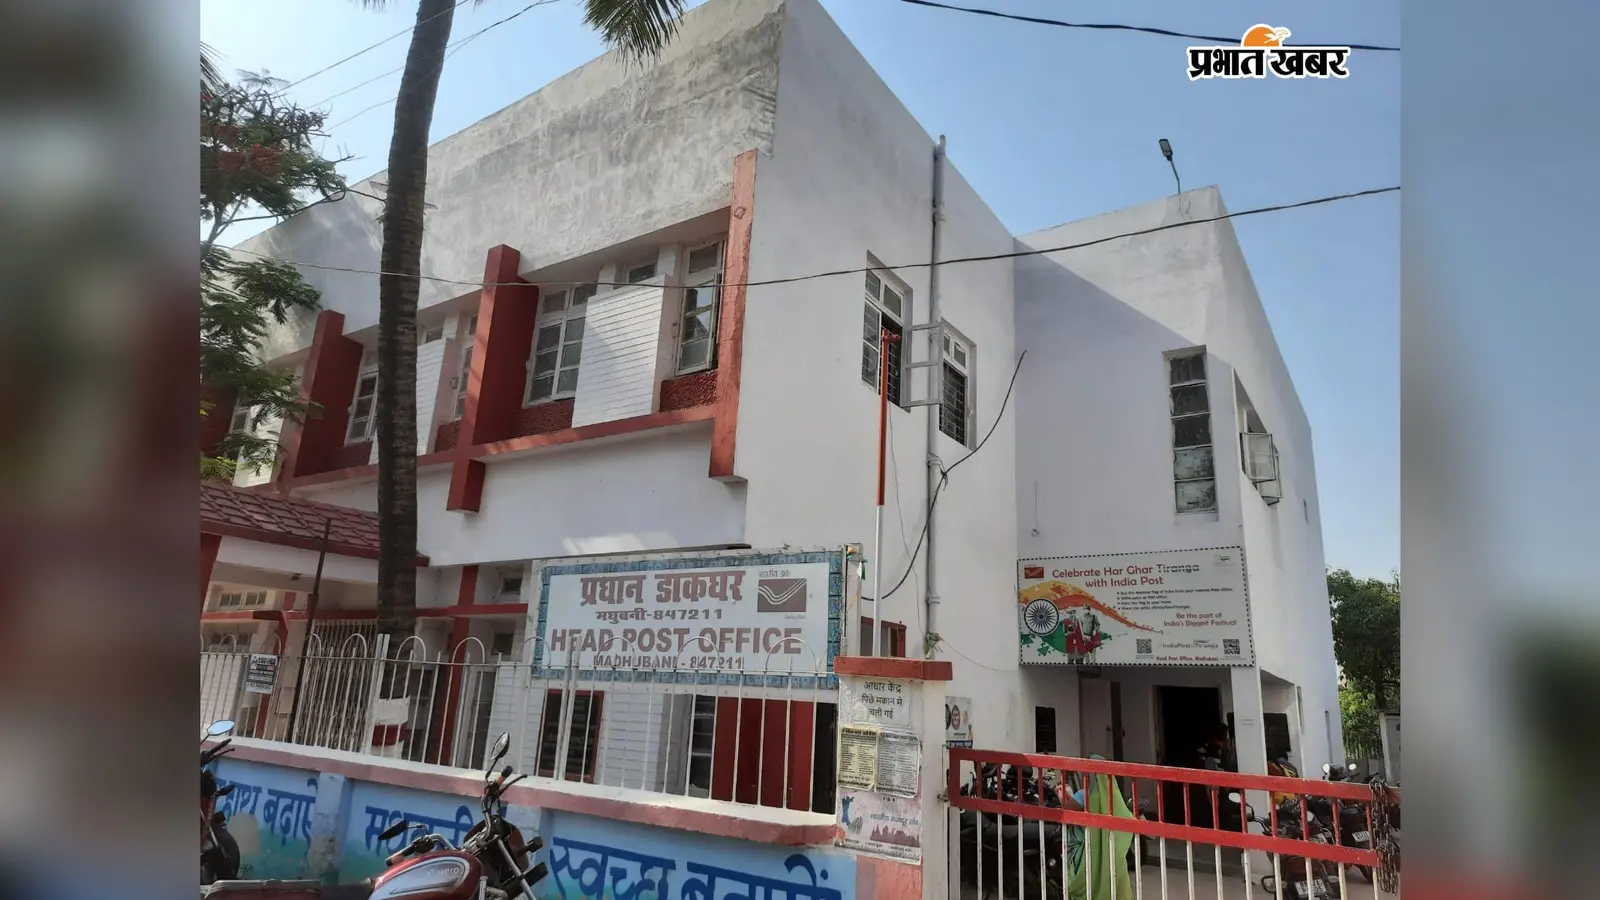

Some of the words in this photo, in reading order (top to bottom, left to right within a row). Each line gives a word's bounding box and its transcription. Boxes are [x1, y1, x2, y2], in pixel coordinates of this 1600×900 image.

[1052, 568, 1101, 579] Celebrate
[1103, 567, 1123, 577] Har
[1127, 565, 1153, 575] Ghar
[1156, 563, 1200, 574] Tiranga
[580, 574, 646, 606] प्रधान
[654, 570, 746, 603] डाकघर
[1085, 577, 1107, 588] with
[1110, 577, 1137, 587] India
[1140, 576, 1164, 585] Post
[1199, 612, 1213, 620] part
[551, 628, 615, 652] HEAD
[621, 628, 690, 653] POST
[698, 627, 803, 655] OFFICE
[593, 655, 677, 669] MADHUBANI
[690, 656, 743, 669] 847211
[863, 681, 885, 692] आधार
[876, 696, 895, 705] मकान
[869, 706, 883, 717] चली
